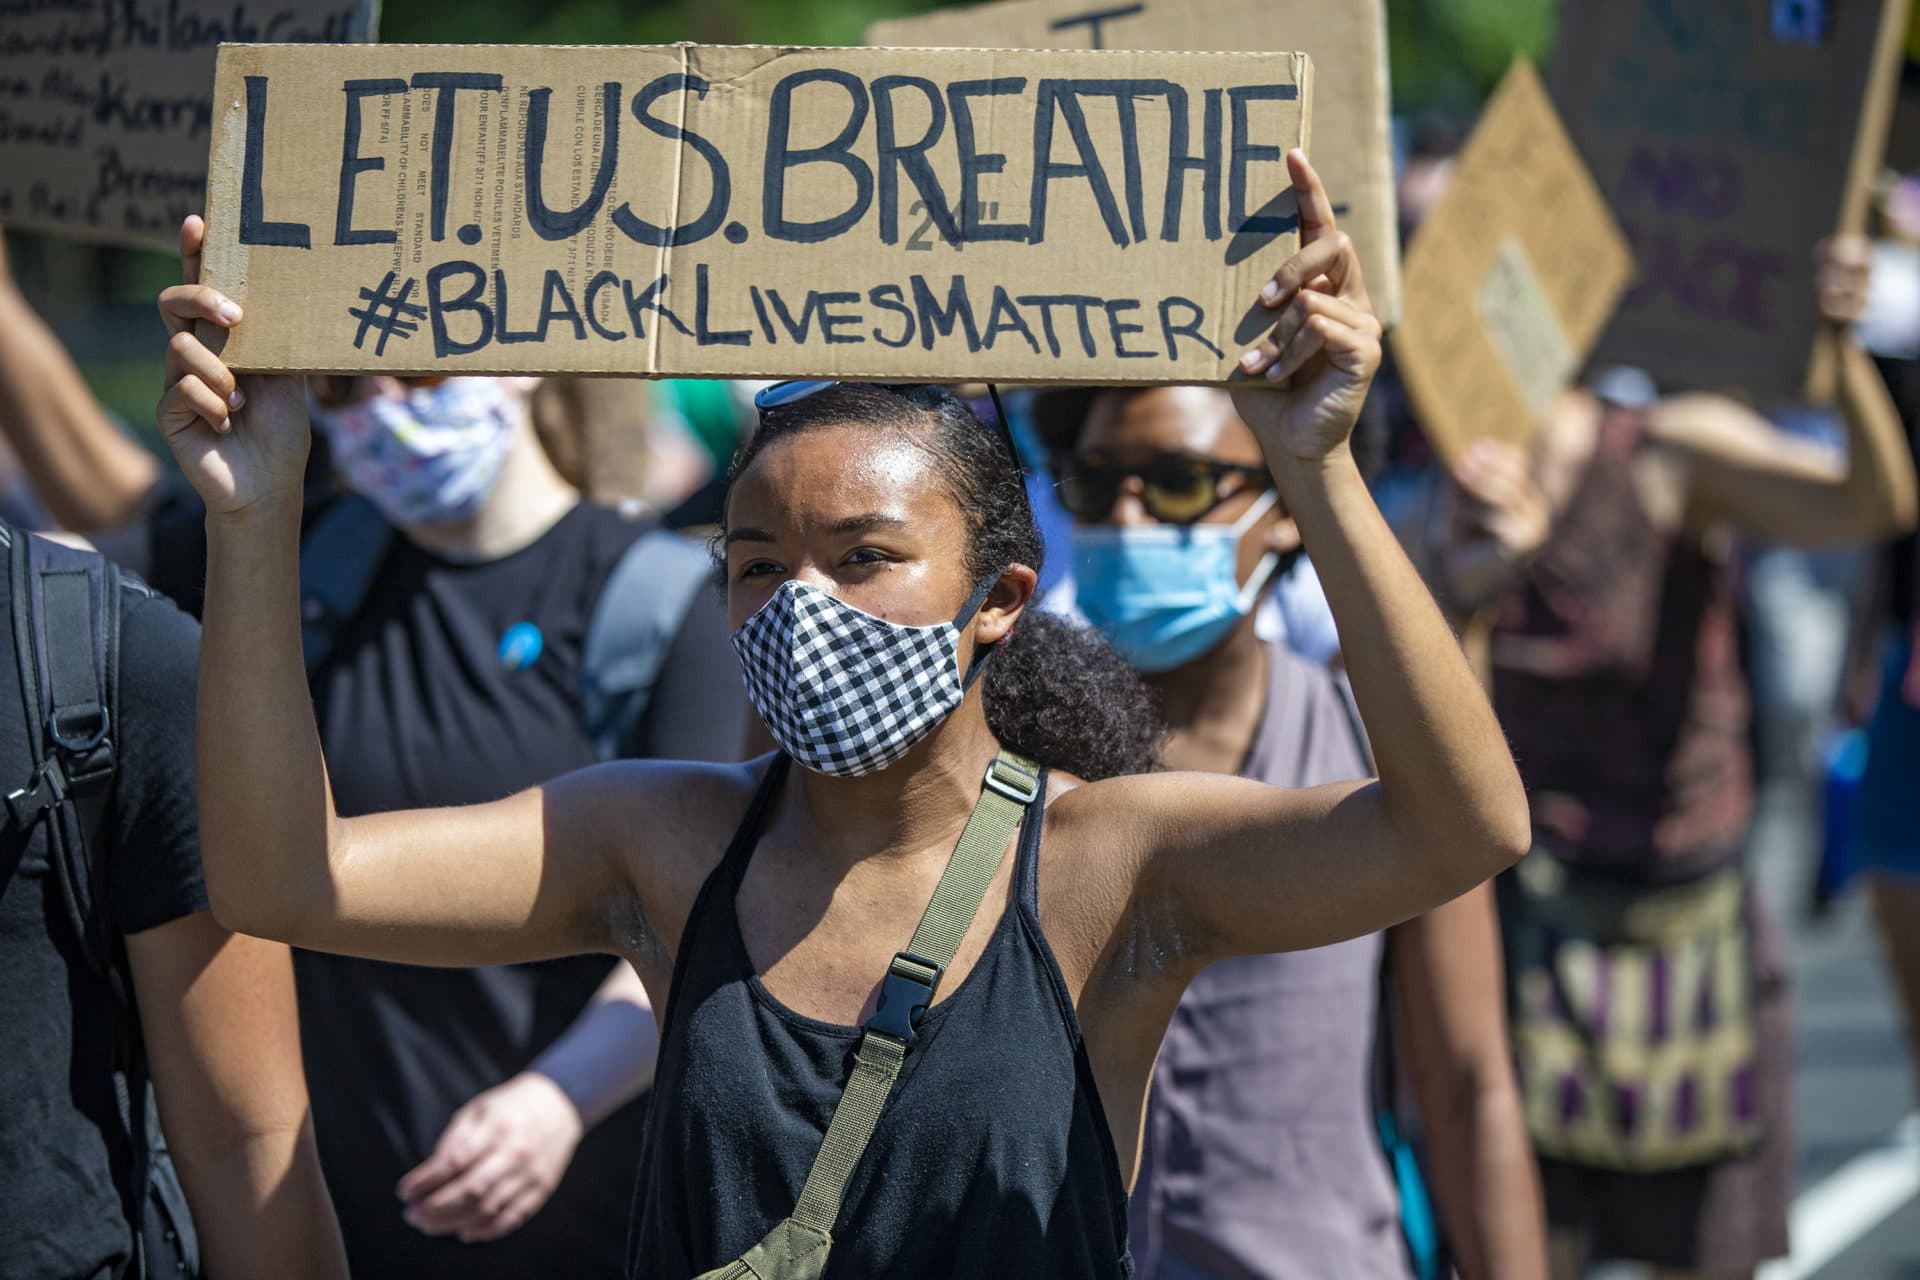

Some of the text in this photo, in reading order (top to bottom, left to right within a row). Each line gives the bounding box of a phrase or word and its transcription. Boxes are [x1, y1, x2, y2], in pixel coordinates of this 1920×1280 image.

[382, 93, 391, 107] OR
[479, 91, 489, 113] OUR
[575, 86, 586, 124] CUMPLE
[381, 109, 391, 120] FF
[574, 126, 584, 146] CON
[593, 120, 602, 132] DE
[419, 133, 428, 153] NOT
[592, 134, 601, 154] UNA
[572, 149, 582, 167] LOS
[762, 68, 1298, 250] BREATHE
[514, 161, 525, 181] AUX
[416, 170, 427, 196] MEET
[395, 172, 408, 226] CHILDRENS
[473, 188, 483, 208] NOR
[511, 182, 524, 239] STANDARDS
[412, 211, 424, 263] STANDARD
